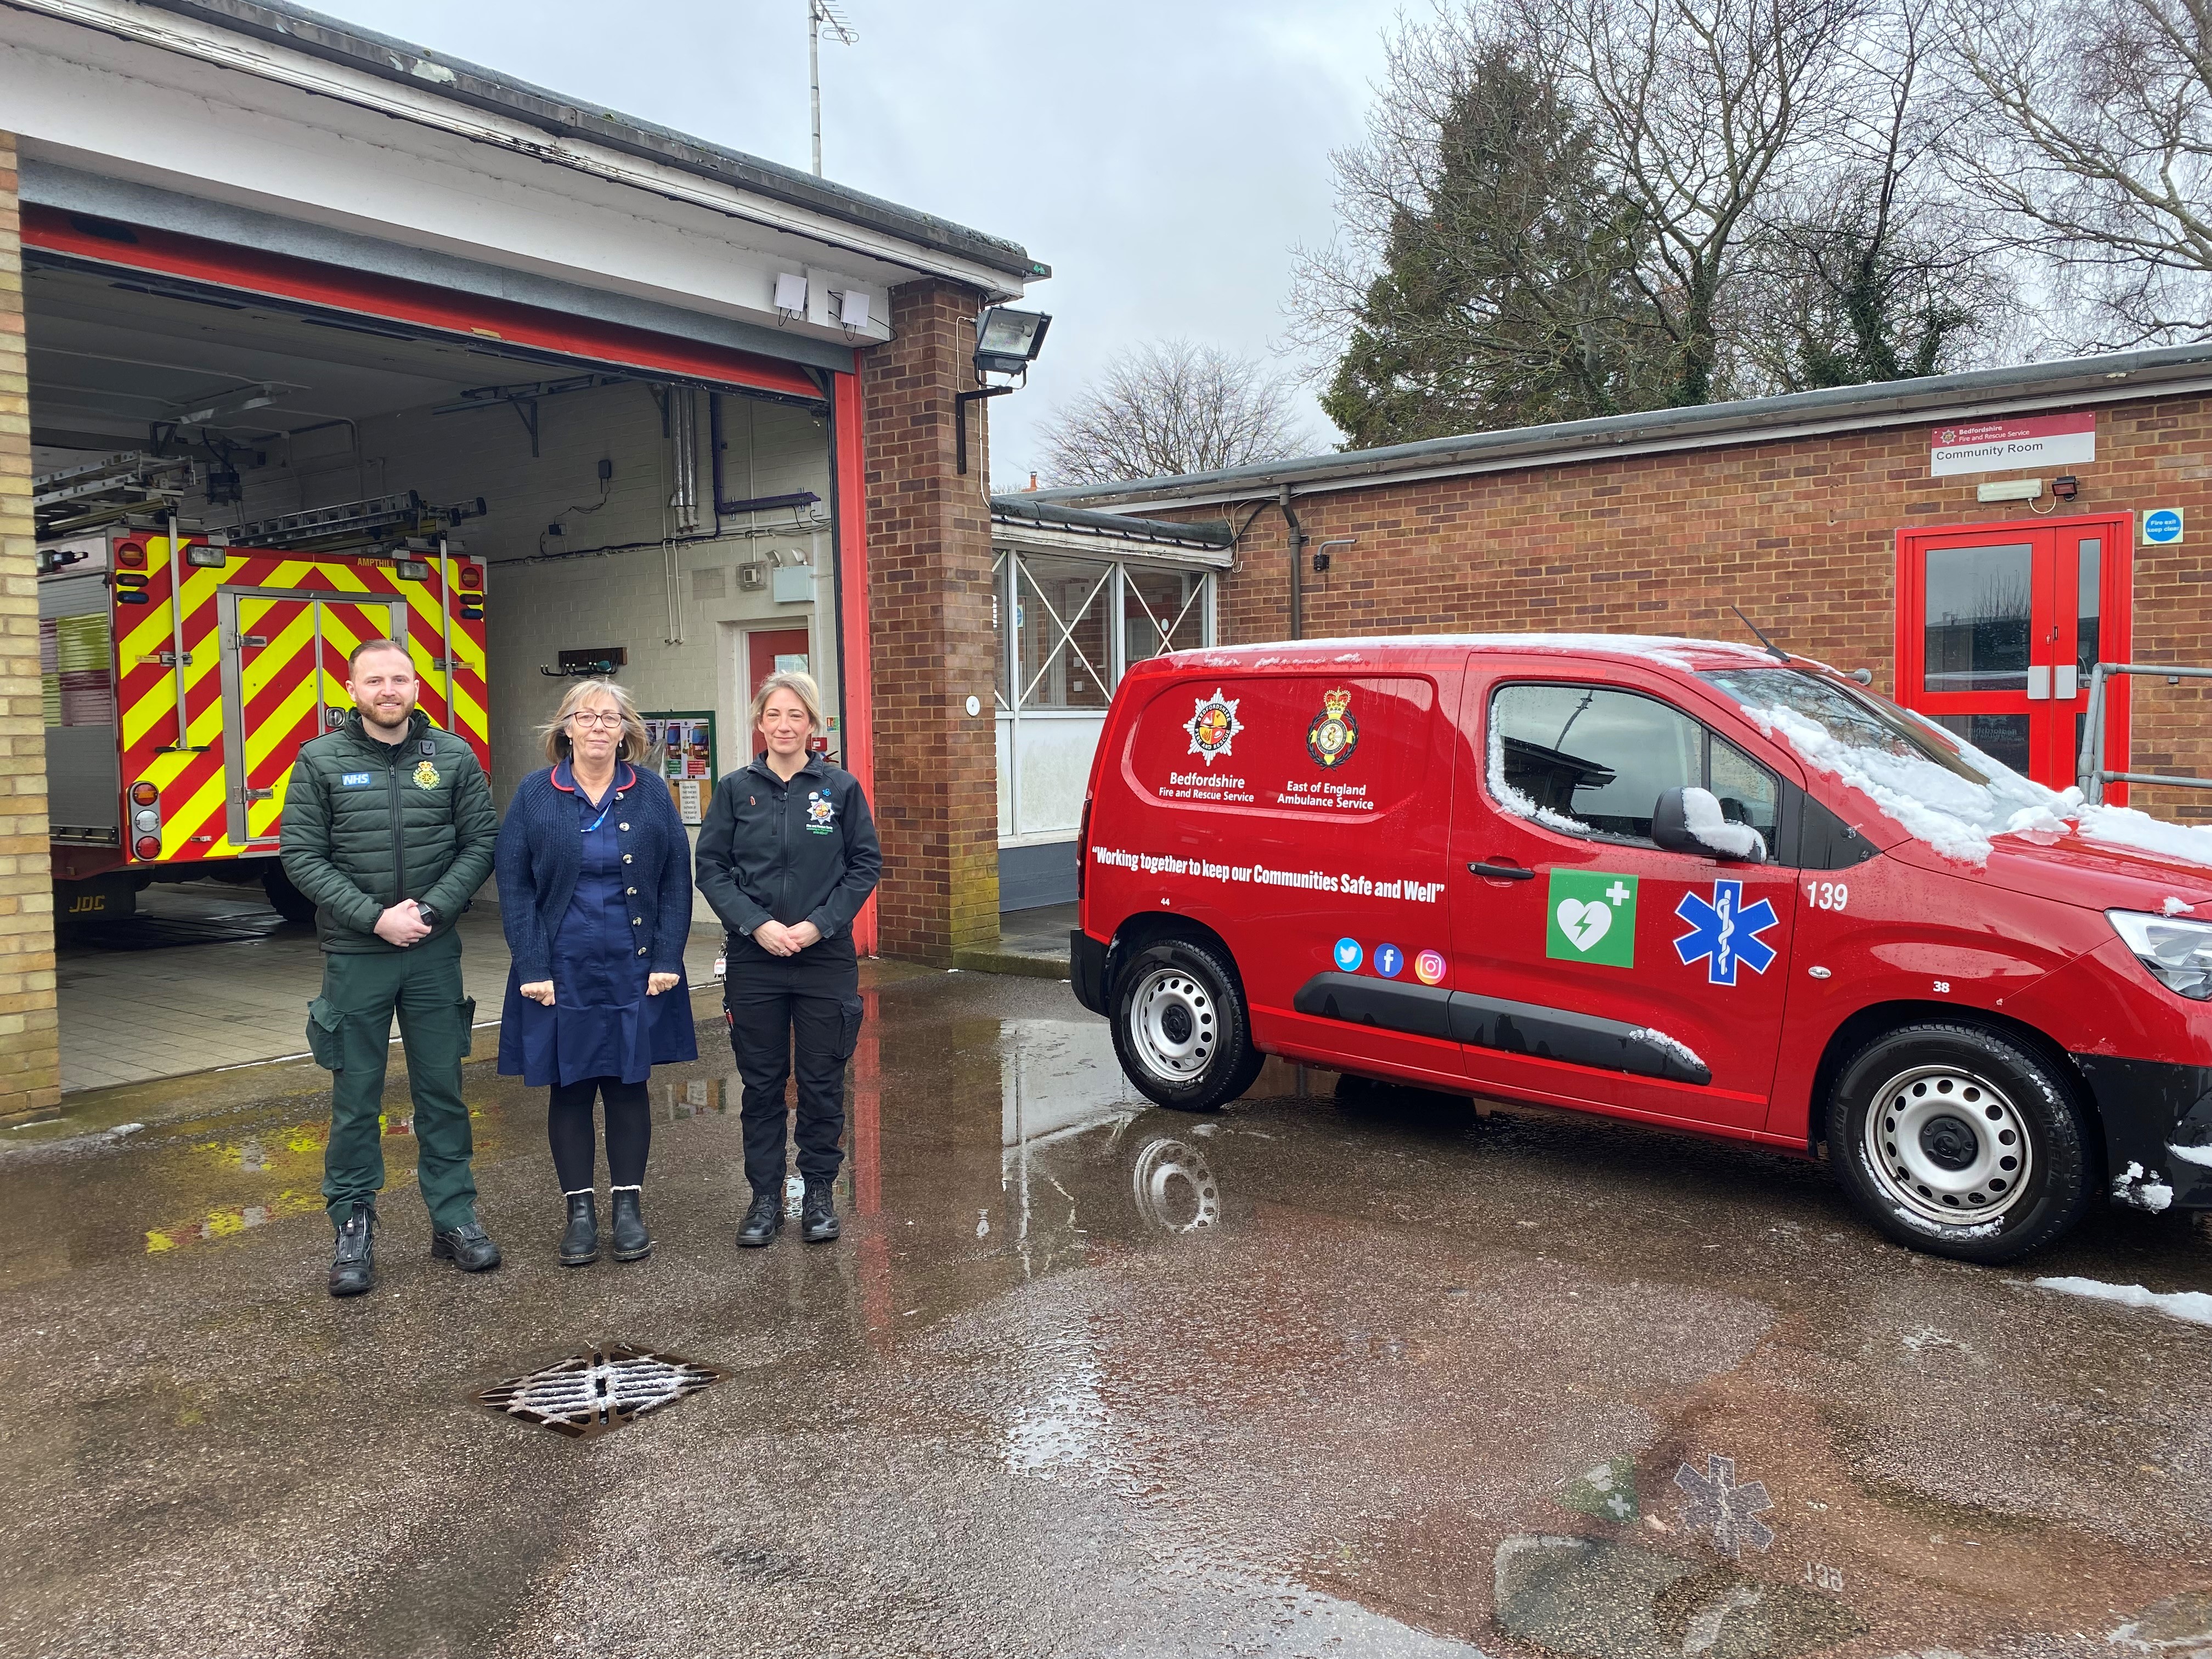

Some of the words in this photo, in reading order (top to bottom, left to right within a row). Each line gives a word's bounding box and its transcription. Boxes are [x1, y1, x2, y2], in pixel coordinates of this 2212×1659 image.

[1959, 425, 2002, 435] Bedfordshire
[1959, 434, 1971, 442] Fire
[2007, 429, 2030, 437] Service
[1936, 445, 2004, 460] Community
[2008, 442, 2043, 454] Room
[357, 557, 395, 568] AMPTHILL
[1197, 704, 1231, 723] BEDFORDSHIRE
[1194, 728, 1203, 744] FIRE
[1213, 730, 1231, 749] RESCUE
[343, 775, 369, 785] NHS
[1170, 772, 1245, 789] Bedfordshire
[1159, 787, 1173, 797] Fire
[1175, 788, 1191, 798] and
[1193, 789, 1222, 800] Rescue
[1223, 791, 1255, 803] Service
[1286, 781, 1308, 793] East
[1310, 782, 1322, 793] of
[1323, 783, 1367, 798] England
[1277, 793, 1334, 807] Ambulance
[1336, 796, 1374, 810] Service
[1140, 852, 1188, 874] together
[1189, 858, 1200, 876] to
[1202, 859, 1229, 883] keep
[1231, 865, 1252, 882] our
[1254, 864, 1339, 892] Communities
[1340, 873, 1373, 896] Safe
[1374, 879, 1402, 900] and
[1160, 898, 1170, 906] 44
[1807, 881, 1848, 911] 139
[1933, 981, 1950, 994] 38
